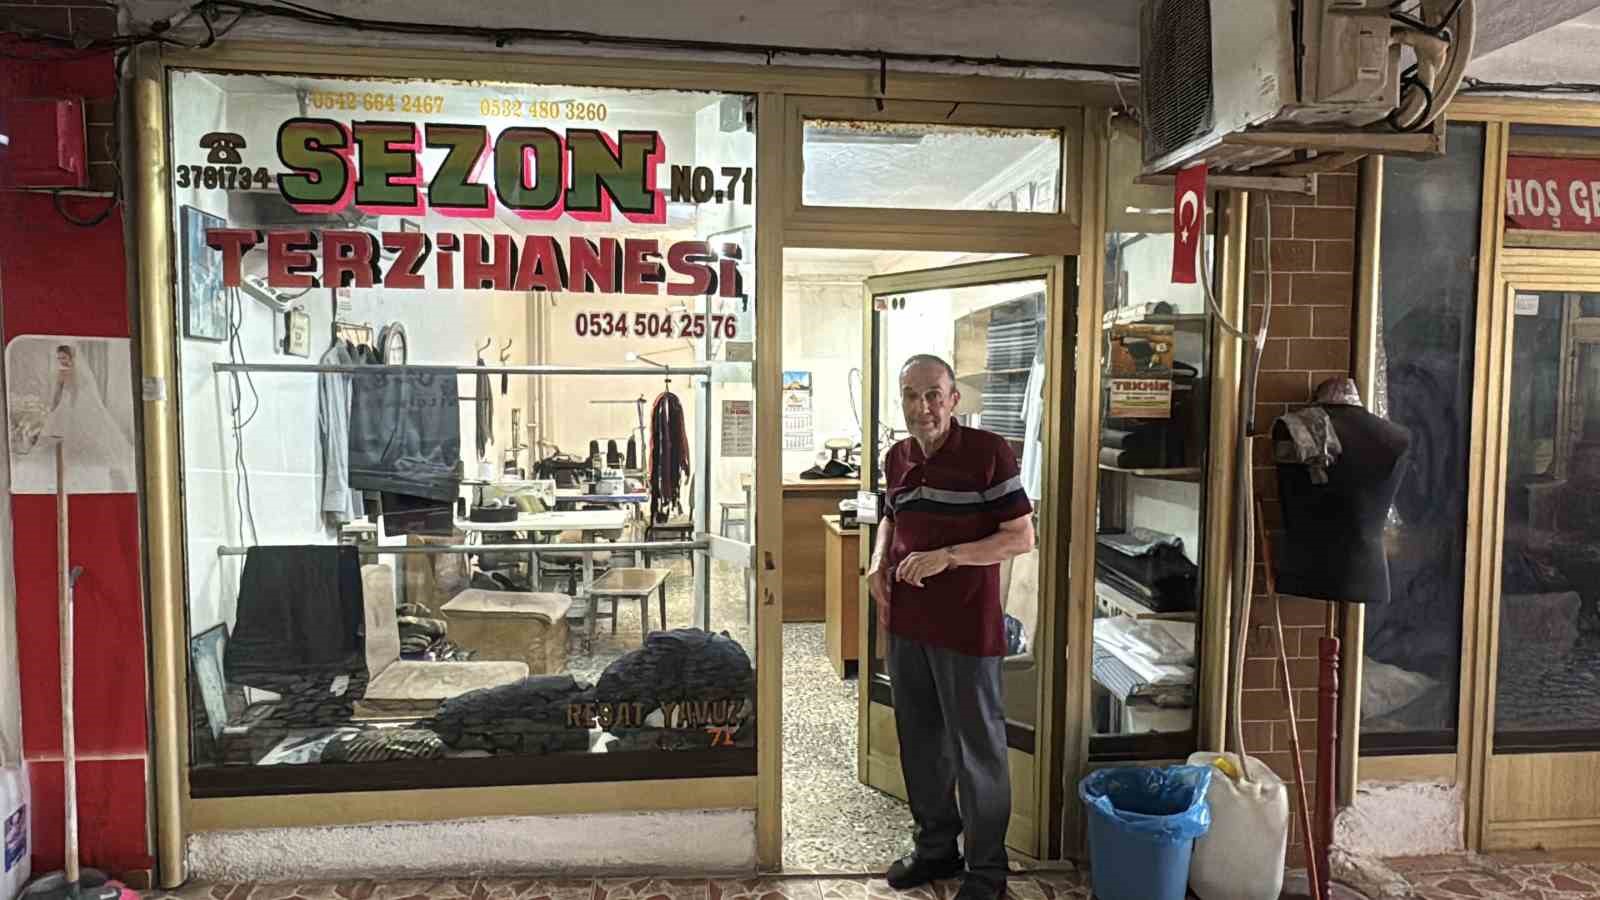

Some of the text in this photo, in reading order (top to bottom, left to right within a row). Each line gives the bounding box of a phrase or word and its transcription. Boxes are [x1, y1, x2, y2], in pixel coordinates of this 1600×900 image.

[311, 91, 445, 113] 0542 664 2467
[479, 98, 607, 121] 0532 480 3260
[177, 165, 271, 190] 3781734
[277, 117, 667, 224] SEZON
[671, 165, 753, 205] NO.71
[1505, 178, 1562, 228] HOŞ
[575, 313, 736, 339] 0534 504 25 76
[703, 727, 737, 747] 71
